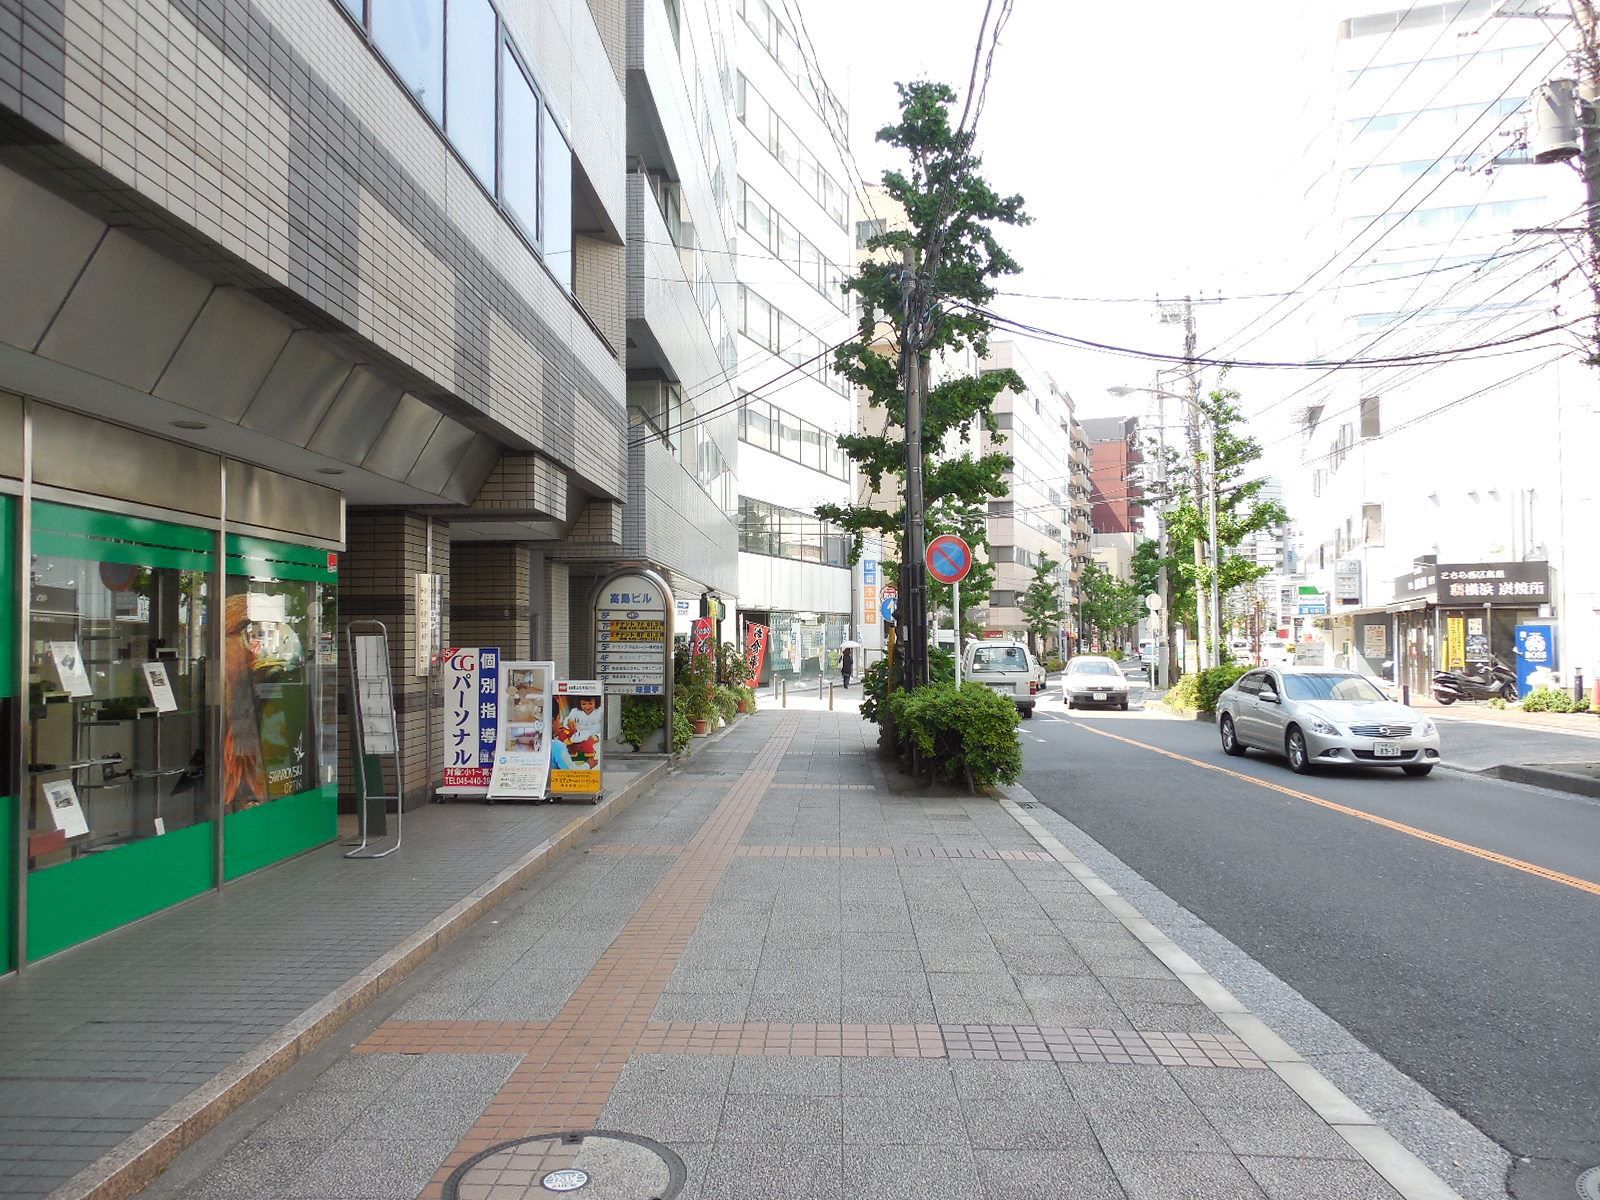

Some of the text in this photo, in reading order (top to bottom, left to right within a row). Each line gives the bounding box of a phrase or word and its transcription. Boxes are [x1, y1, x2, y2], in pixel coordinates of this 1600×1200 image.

[610, 593, 652, 604] 高島ビル
[451, 654, 475, 671] CG
[452, 673, 472, 766] パーソナル
[480, 653, 496, 744] 個別指導
